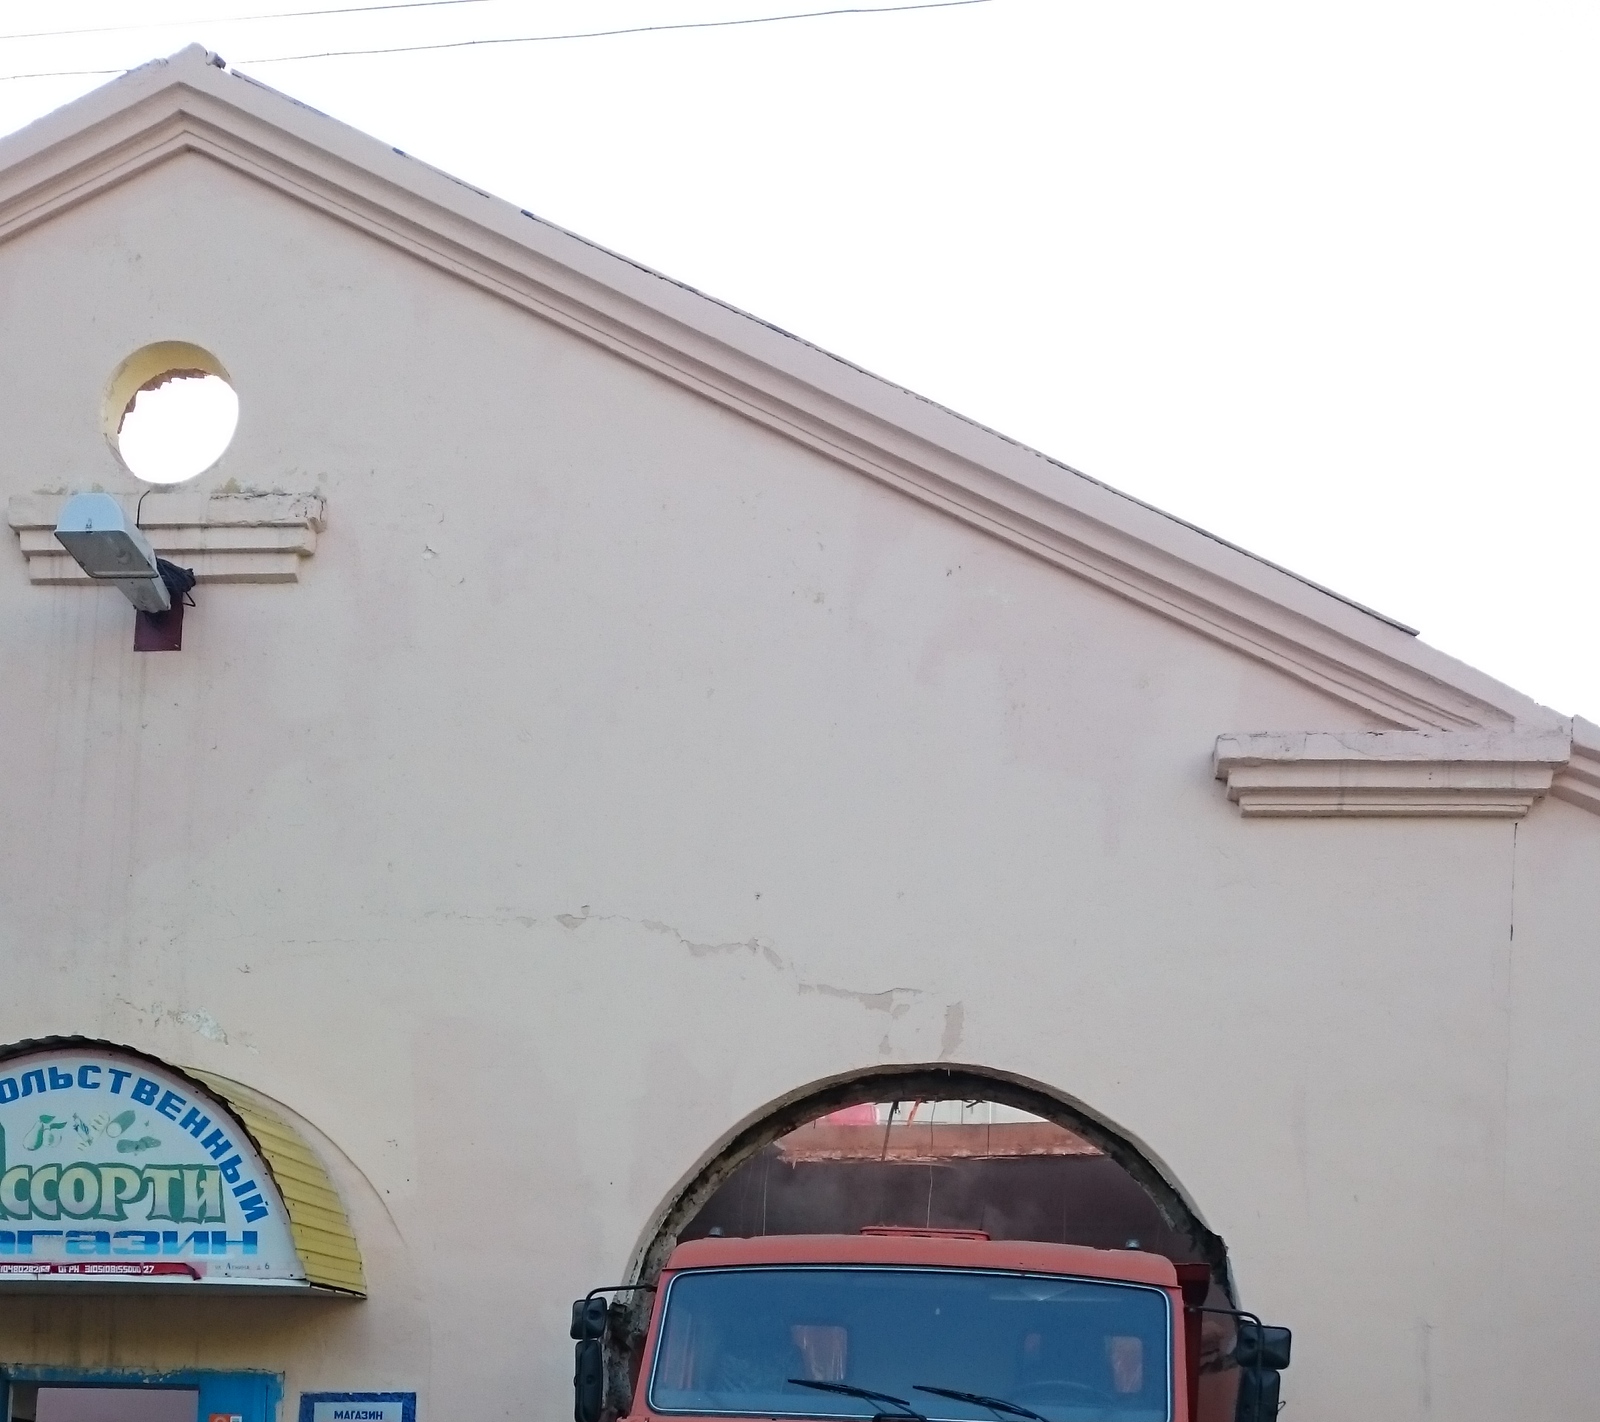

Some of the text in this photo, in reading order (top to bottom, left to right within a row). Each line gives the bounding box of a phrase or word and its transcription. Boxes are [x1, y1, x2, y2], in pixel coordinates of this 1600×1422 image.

[0, 1121, 226, 1224] ССОРТИ
[264, 1261, 270, 1270] 6
[334, 1410, 383, 1420] МАГАЗИН
